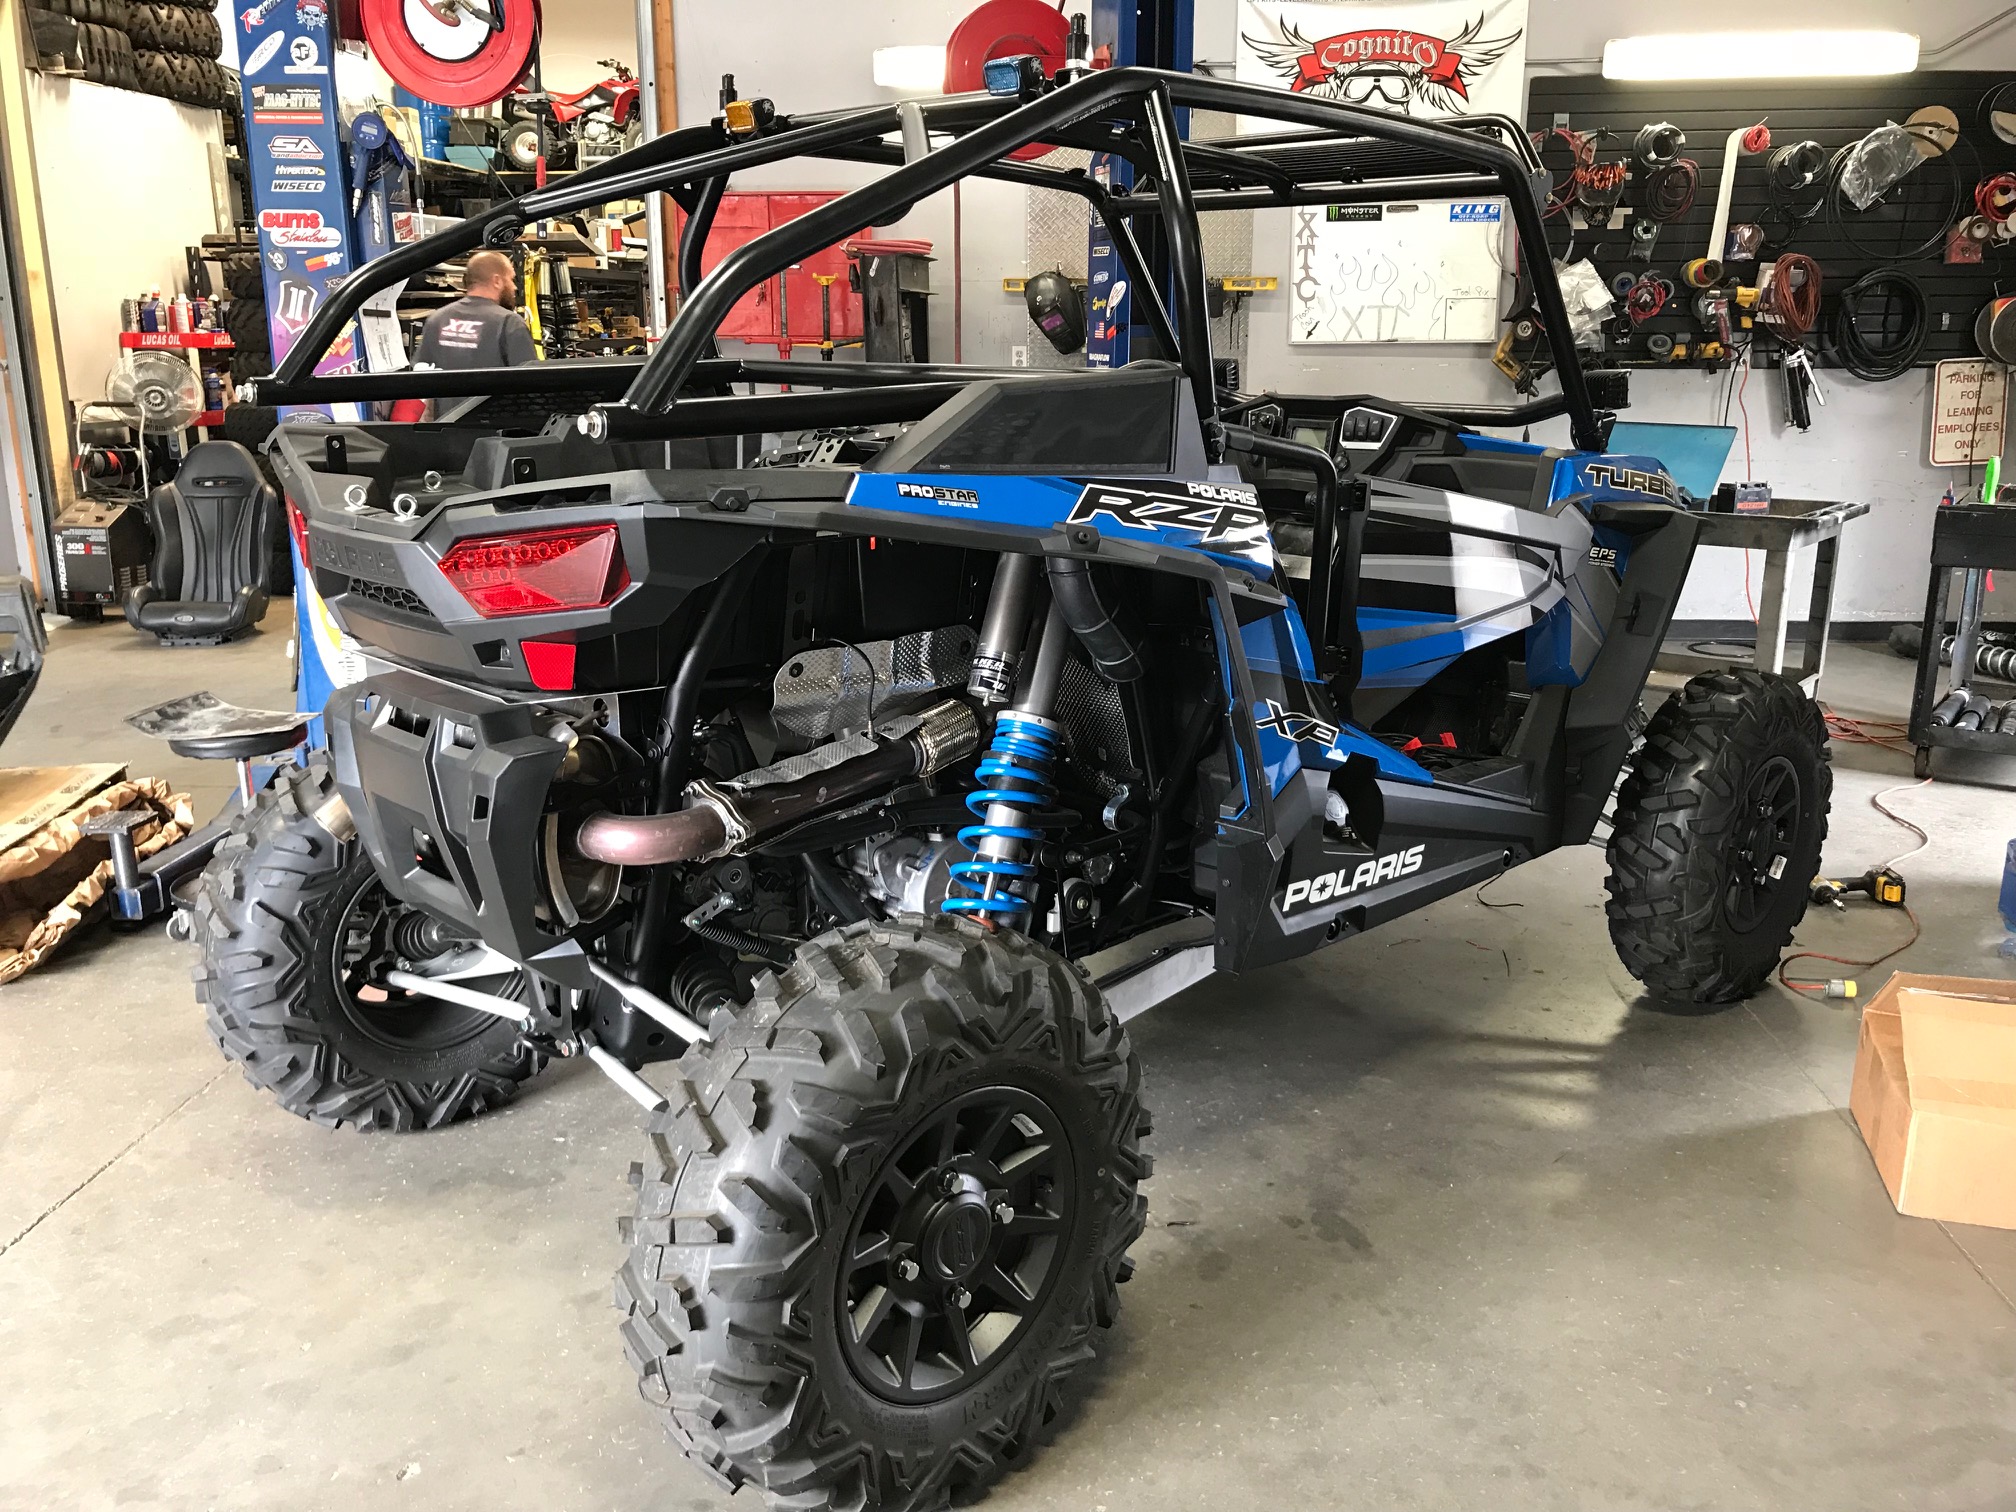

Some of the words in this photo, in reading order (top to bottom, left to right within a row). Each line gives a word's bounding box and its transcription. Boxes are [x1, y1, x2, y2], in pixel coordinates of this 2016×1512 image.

[1452, 204, 1500, 214] KING
[442, 318, 484, 333] XTC
[142, 335, 166, 345] LUCAS
[168, 335, 181, 345] OIL
[214, 336, 231, 345] LUCAS
[1949, 373, 1996, 384] PARKING
[1960, 389, 1982, 400] FOR
[1938, 422, 2000, 434] EMPLOYEES
[1585, 463, 1676, 504] TURBO
[1187, 482, 1258, 505] POLARIS
[1590, 546, 1617, 559] EPS
[1256, 698, 1339, 748] XP
[1282, 844, 1426, 912] POLARIS
